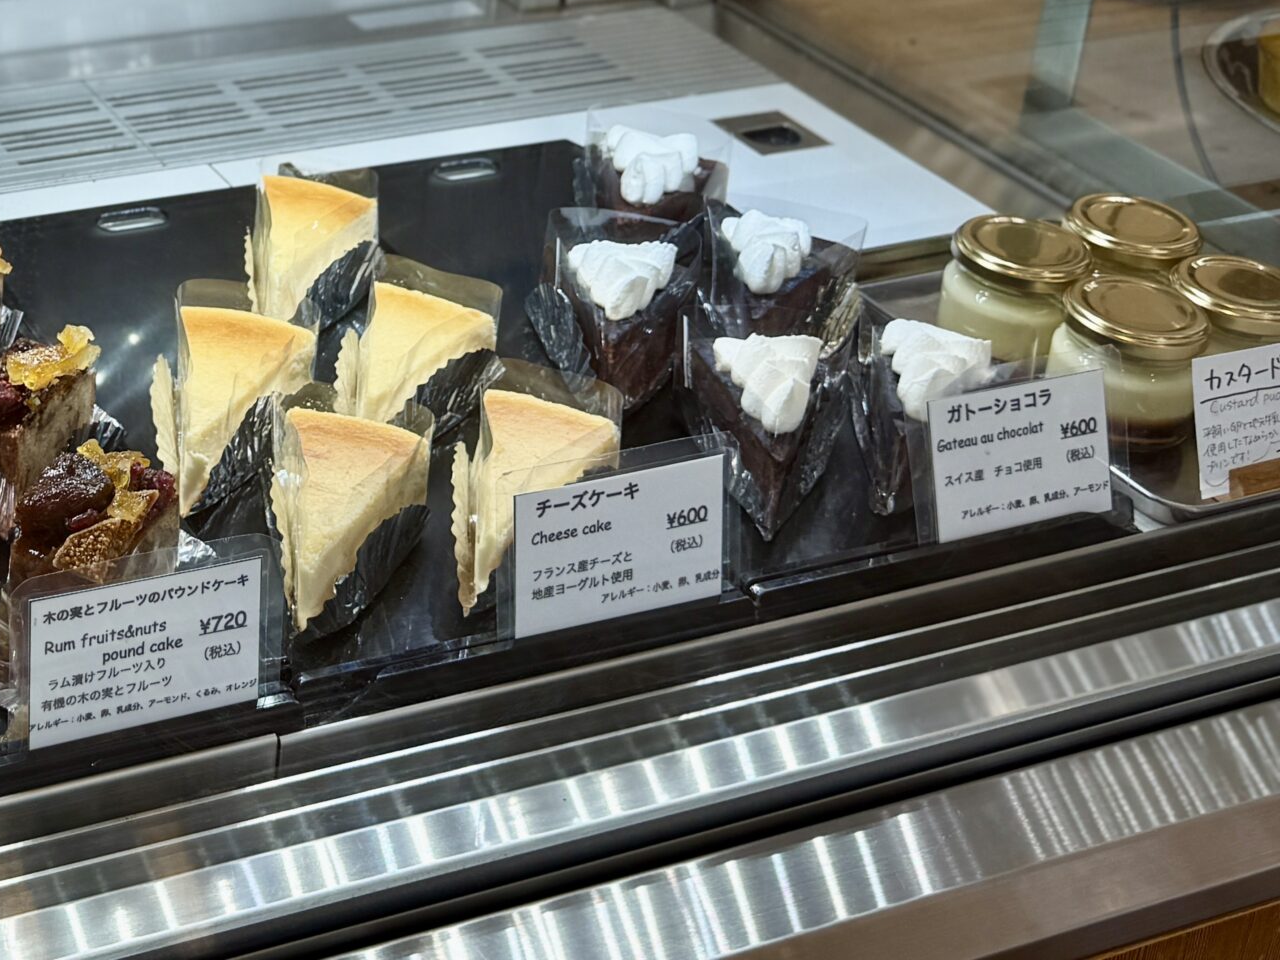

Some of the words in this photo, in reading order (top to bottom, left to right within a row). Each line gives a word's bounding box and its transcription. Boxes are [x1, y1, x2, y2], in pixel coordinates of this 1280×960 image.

[948, 389, 1051, 424] ガトーショコラ
[1210, 391, 1259, 413] Custard
[937, 435, 977, 452] Gateau
[980, 432, 993, 444] au
[997, 422, 1044, 441] chocolat
[1061, 418, 1097, 439] ¥600
[945, 469, 984, 486] スイス産
[994, 457, 1042, 477] チョコ使用
[536, 482, 640, 518] チーズケーキ
[667, 505, 708, 529] ¥600
[532, 527, 577, 545] Cheese
[583, 520, 612, 534] cake
[671, 535, 703, 553] （税込）
[533, 552, 633, 582] フランス産チーズと
[43, 574, 249, 624] 木の実とフルーツのパウンドケーキ
[532, 569, 633, 600] 地産ヨーグルト使用
[45, 641, 75, 655] Rum
[81, 620, 166, 648] fruits&nuts
[199, 611, 247, 635] ¥720
[102, 642, 144, 665] pound
[150, 637, 183, 653] cake
[204, 641, 241, 660] （税込）
[48, 657, 165, 690] ラム漬けフルーツ入り
[41, 676, 172, 712] 有機の木の実とフルーツ
